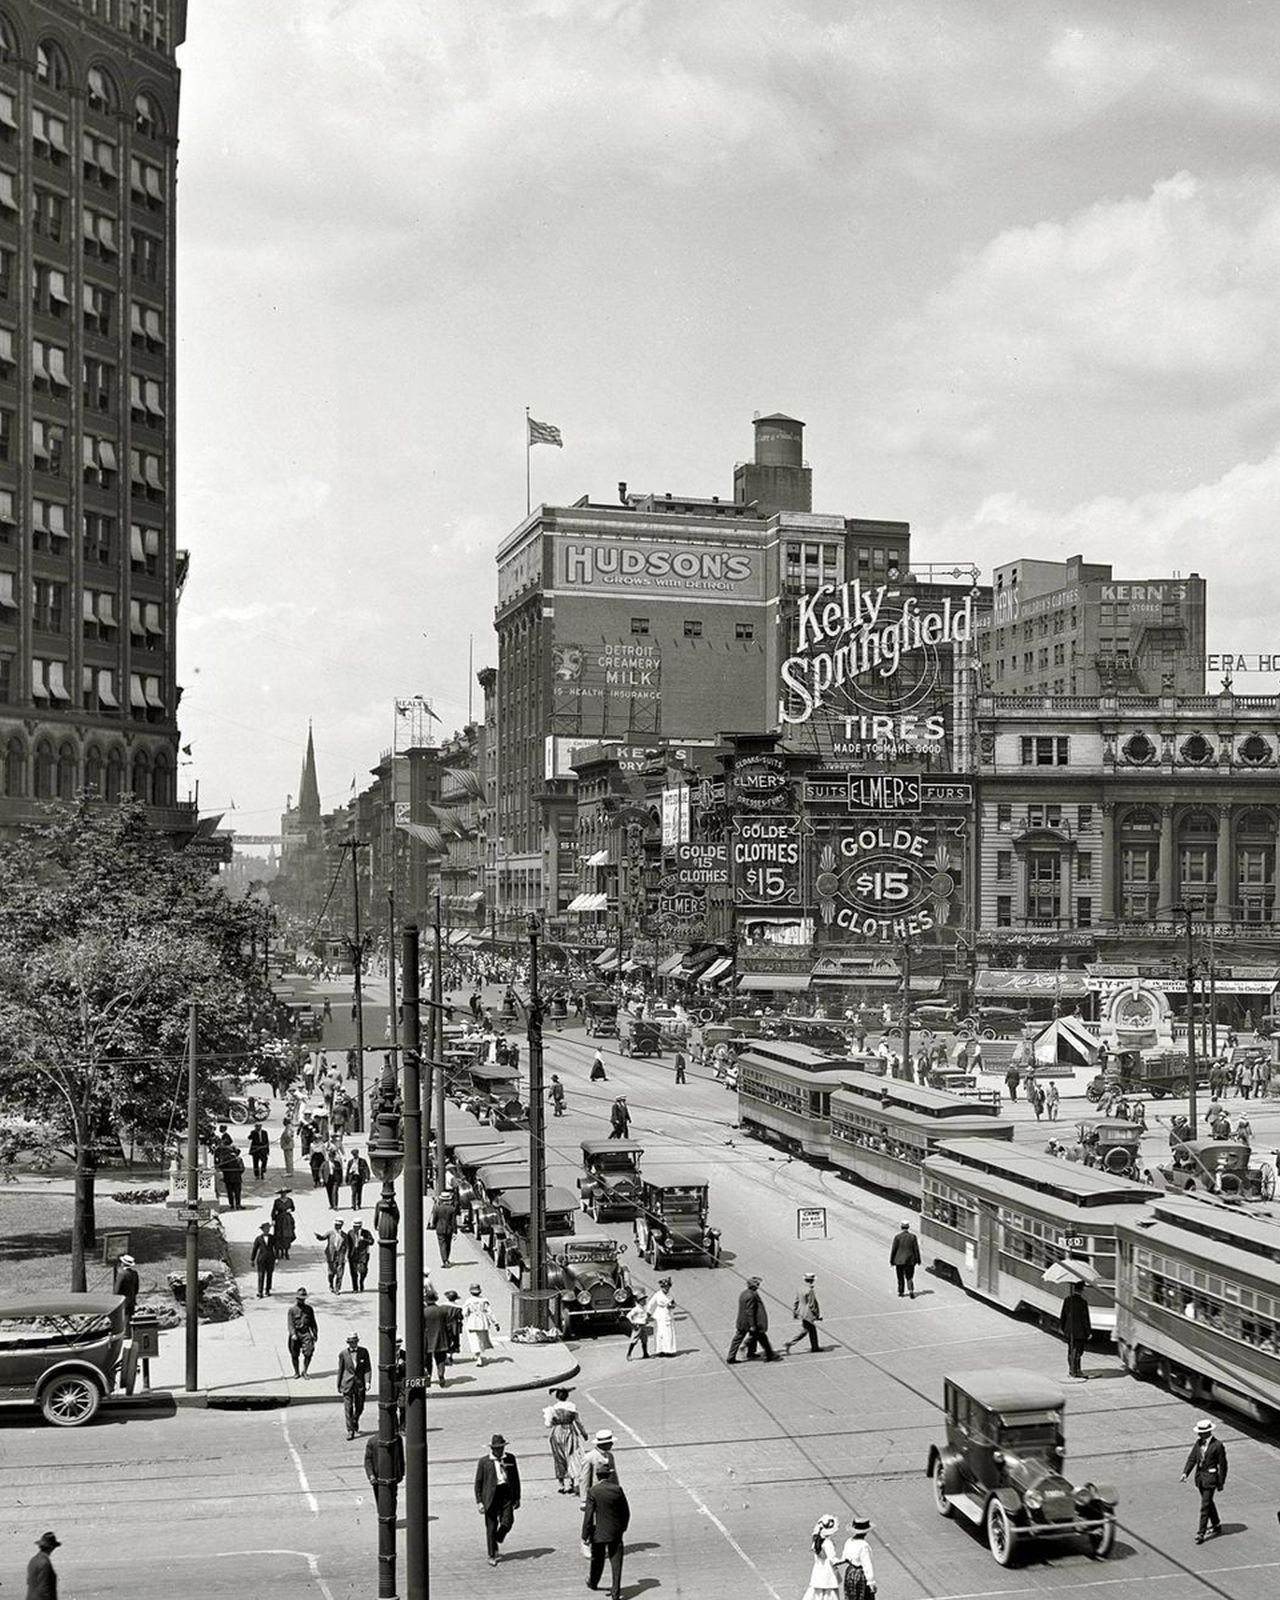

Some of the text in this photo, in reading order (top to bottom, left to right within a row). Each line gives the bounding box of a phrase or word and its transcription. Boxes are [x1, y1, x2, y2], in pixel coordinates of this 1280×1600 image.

[566, 544, 753, 585] HUDSON'S
[603, 575, 651, 587] GROWS
[686, 580, 736, 592] DETROIT
[1101, 585, 1187, 601] KERN'S
[604, 644, 655, 656] DETROIT
[598, 656, 662, 670] CREAMERY
[778, 595, 973, 724] Springfield
[606, 670, 652, 686] MILK
[568, 687, 604, 697] HEALTH
[610, 689, 662, 700] INSURANCE
[843, 715, 946, 740] TIRES
[834, 743, 942, 755] MADE TO MAKE GOOD
[619, 760, 645, 772] DRY
[733, 775, 786, 788] ELMER'S
[806, 775, 965, 810] SUITS ELMER'S FURS
[741, 824, 788, 839] GOLDE
[839, 827, 929, 858] GOLDE
[679, 845, 728, 861] GOLDE
[734, 842, 799, 866] CLOTHES
[679, 869, 728, 882] CLOTHES
[745, 866, 786, 897] $15
[855, 871, 911, 901] $15
[835, 907, 935, 945] CLOTHES
[405, 1377, 426, 1389] FORT
